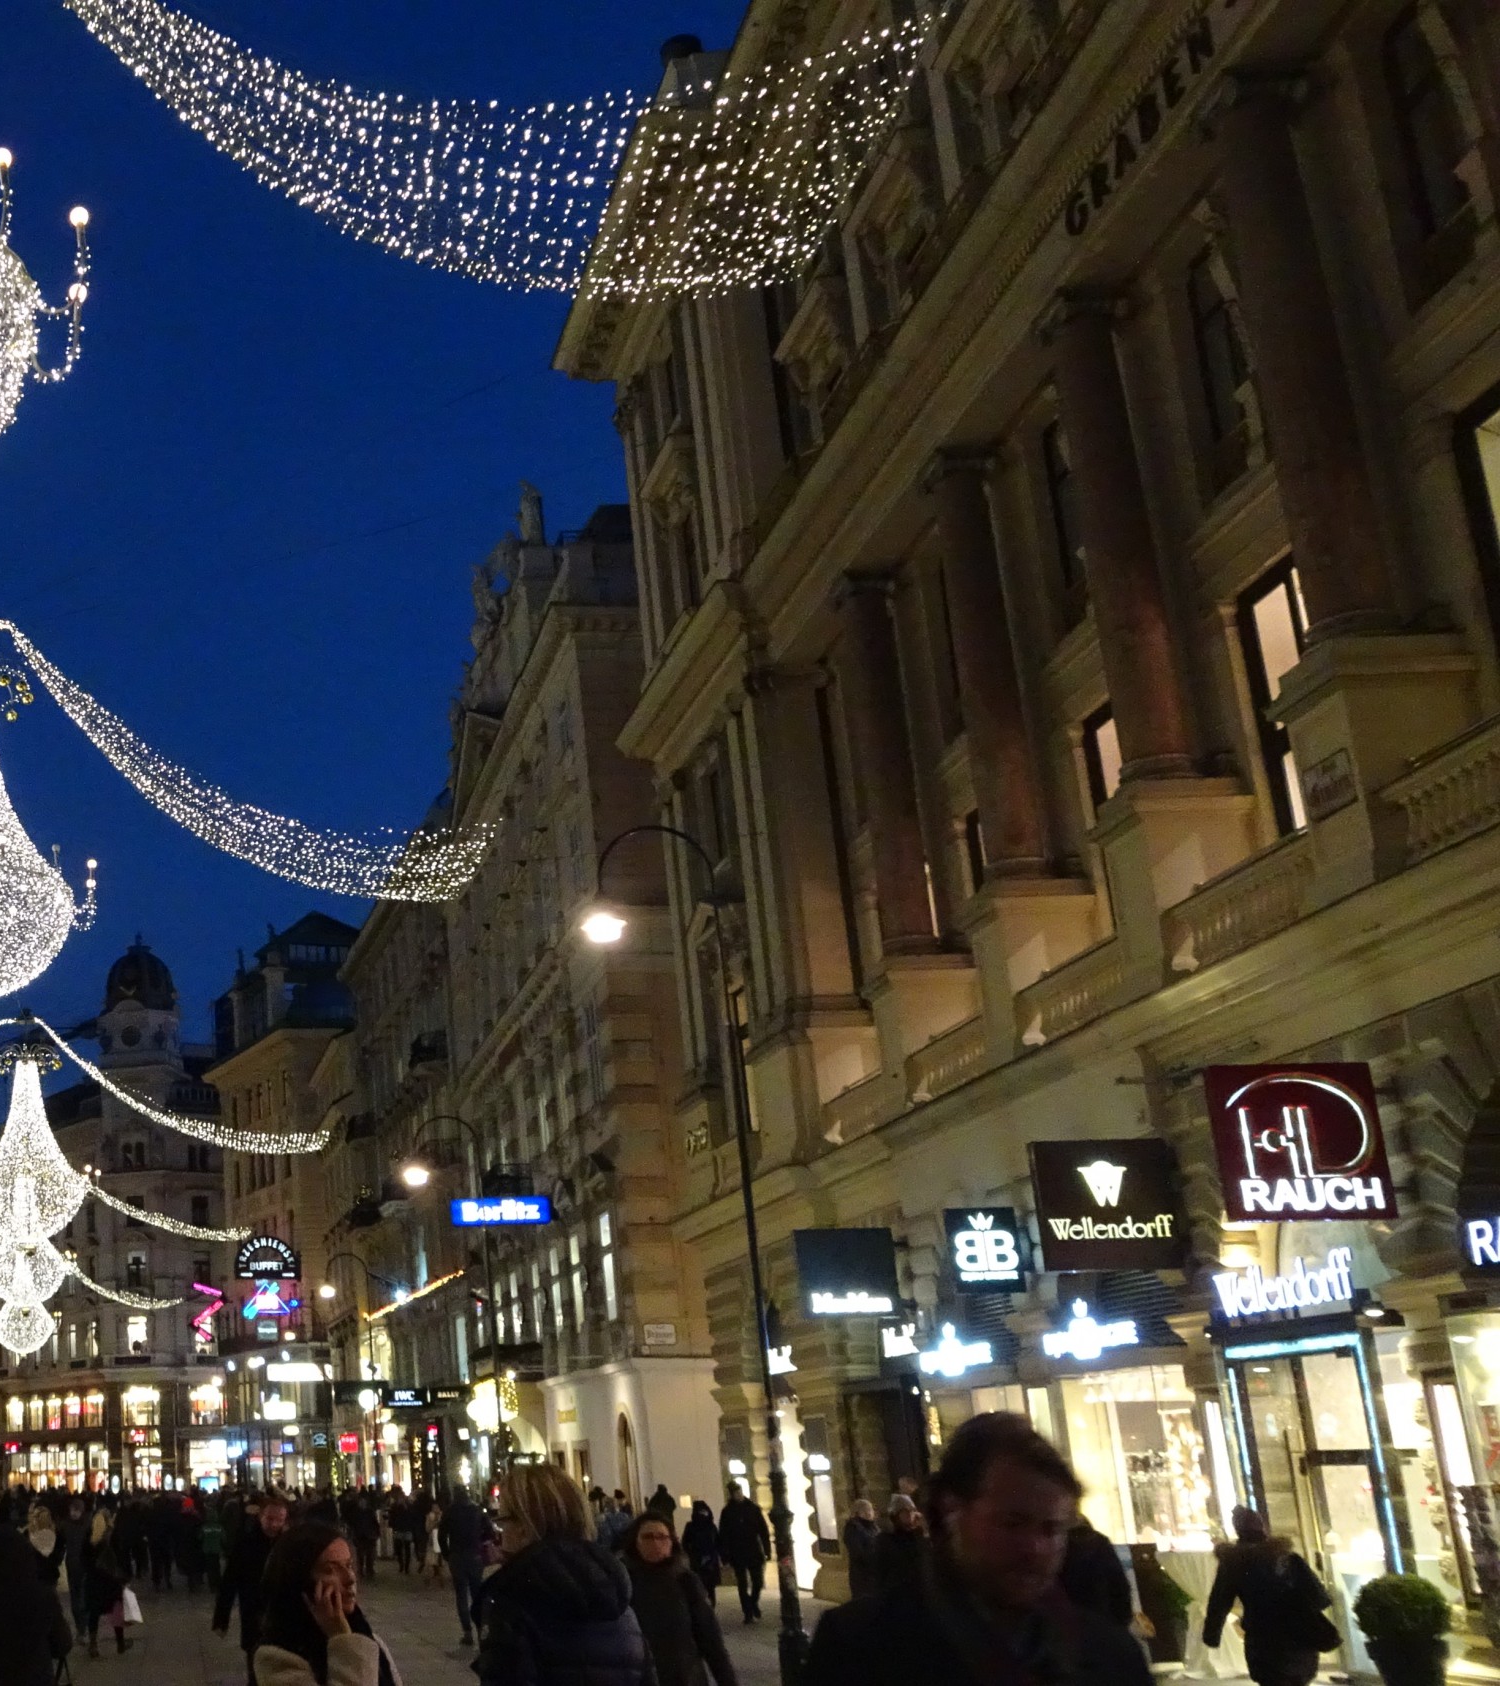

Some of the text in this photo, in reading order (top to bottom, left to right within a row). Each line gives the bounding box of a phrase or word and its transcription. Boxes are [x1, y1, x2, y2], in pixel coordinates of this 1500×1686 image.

[1065, 0, 1236, 236] GRABEN
[1240, 1177, 1386, 1211] RAUCH
[461, 1199, 541, 1222] Berlitz
[1048, 1214, 1174, 1241] Wellendorff
[1467, 1217, 1500, 1266] R
[249, 1261, 284, 1271] BUFFET
[1212, 1247, 1353, 1318] Wellendorff
[395, 1390, 415, 1401] IWC
